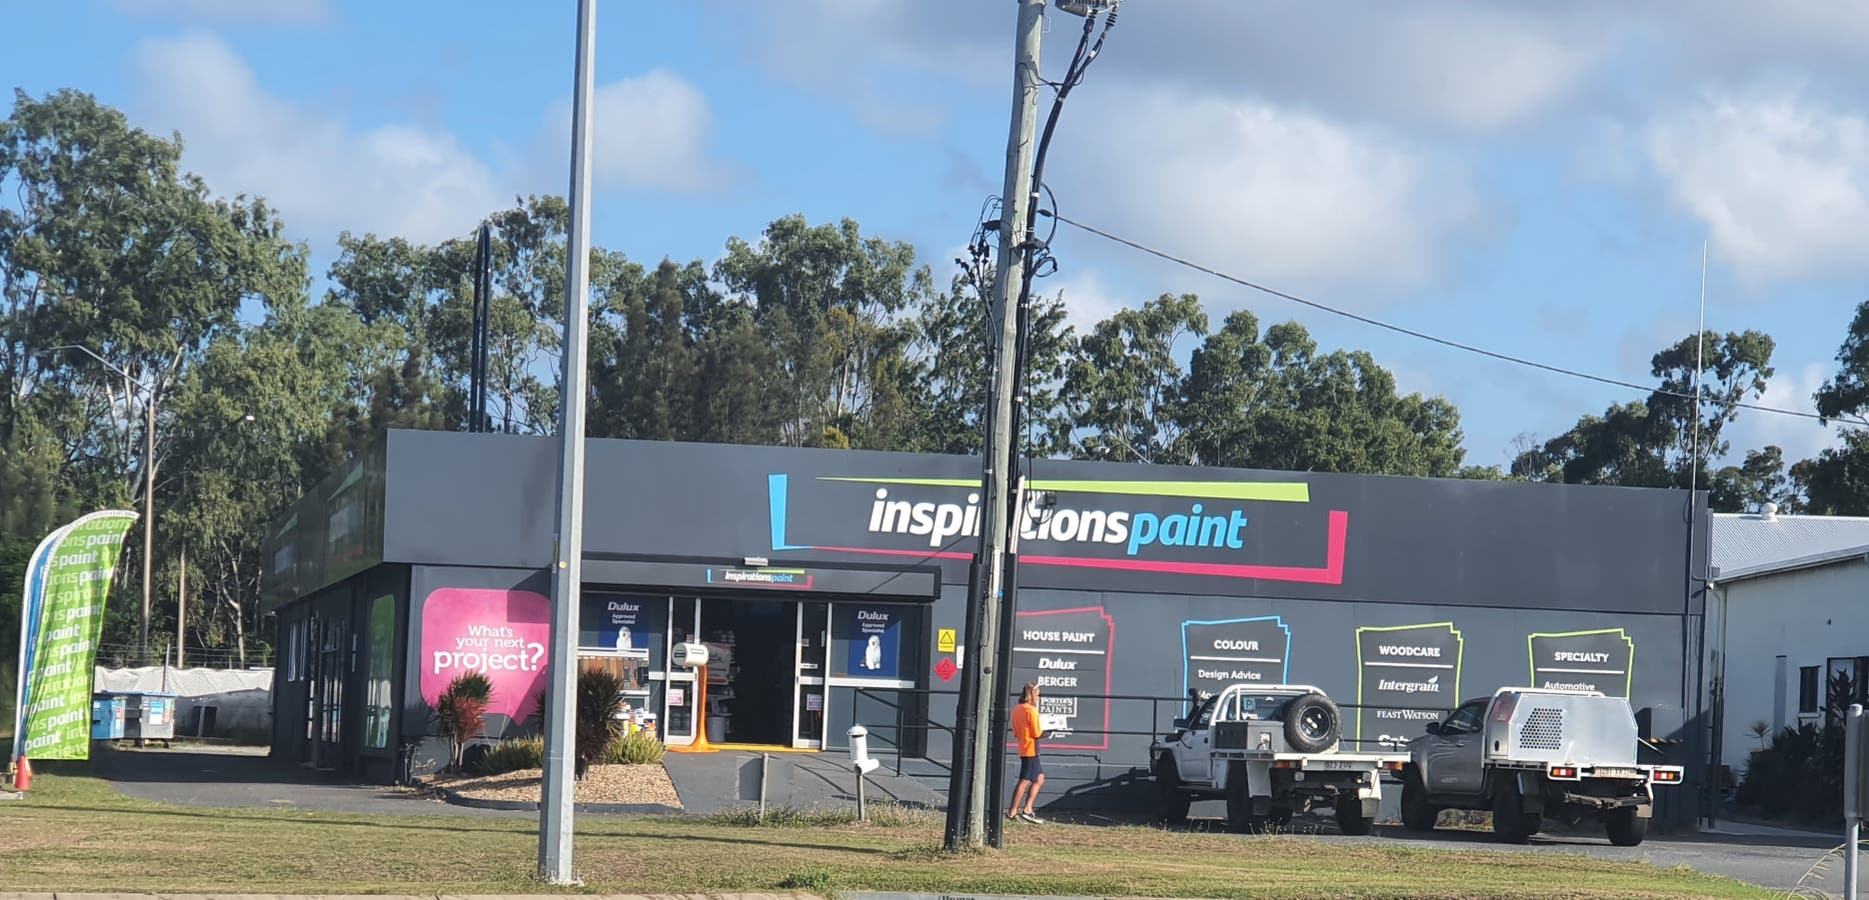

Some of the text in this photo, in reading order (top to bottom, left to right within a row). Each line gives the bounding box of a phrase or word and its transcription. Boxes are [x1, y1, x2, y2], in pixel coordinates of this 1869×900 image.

[608, 601, 640, 611] Dulux
[857, 610, 888, 621] Dulux
[467, 625, 513, 638] What's
[1023, 630, 1095, 643] HOUSE PAINT
[456, 637, 524, 650] your next
[1213, 640, 1259, 651] COLOUR
[1379, 646, 1440, 657] WOODCARE
[1554, 651, 1609, 663] SPECIALTY
[434, 642, 544, 674] project?
[1038, 658, 1078, 670] Dulux
[1198, 669, 1261, 680] Design Advice
[1038, 676, 1077, 687] BERGER
[1378, 678, 1439, 693] Intergrain
[1544, 681, 1595, 691] Automotive
[1040, 706, 1073, 714] PAINTS
[1377, 709, 1439, 720] FEAST WATSON
